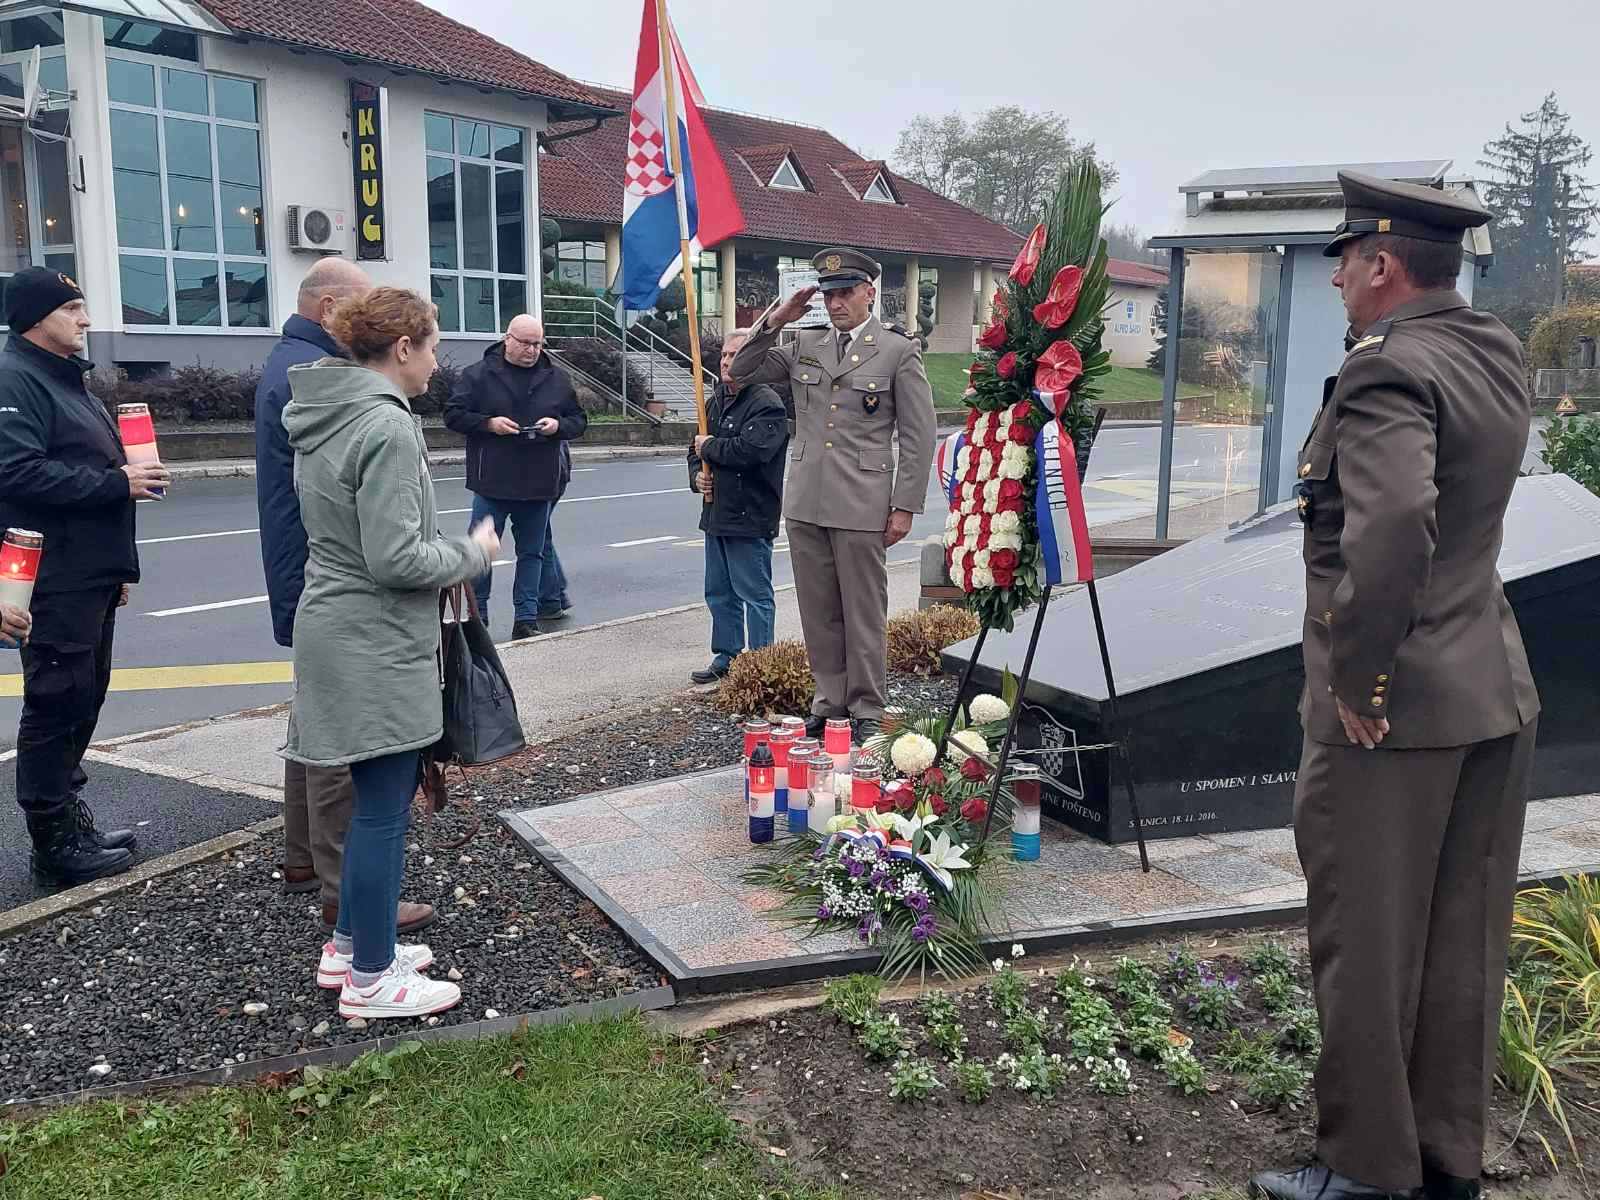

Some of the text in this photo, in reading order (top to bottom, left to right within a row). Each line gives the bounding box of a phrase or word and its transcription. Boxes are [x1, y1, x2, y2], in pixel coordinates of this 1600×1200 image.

[358, 108, 381, 242] KRUG
[1180, 782, 1191, 792] U
[1195, 777, 1246, 791] SPOMEN
[1250, 775, 1256, 786] I
[1128, 816, 1168, 828] SLNICA
